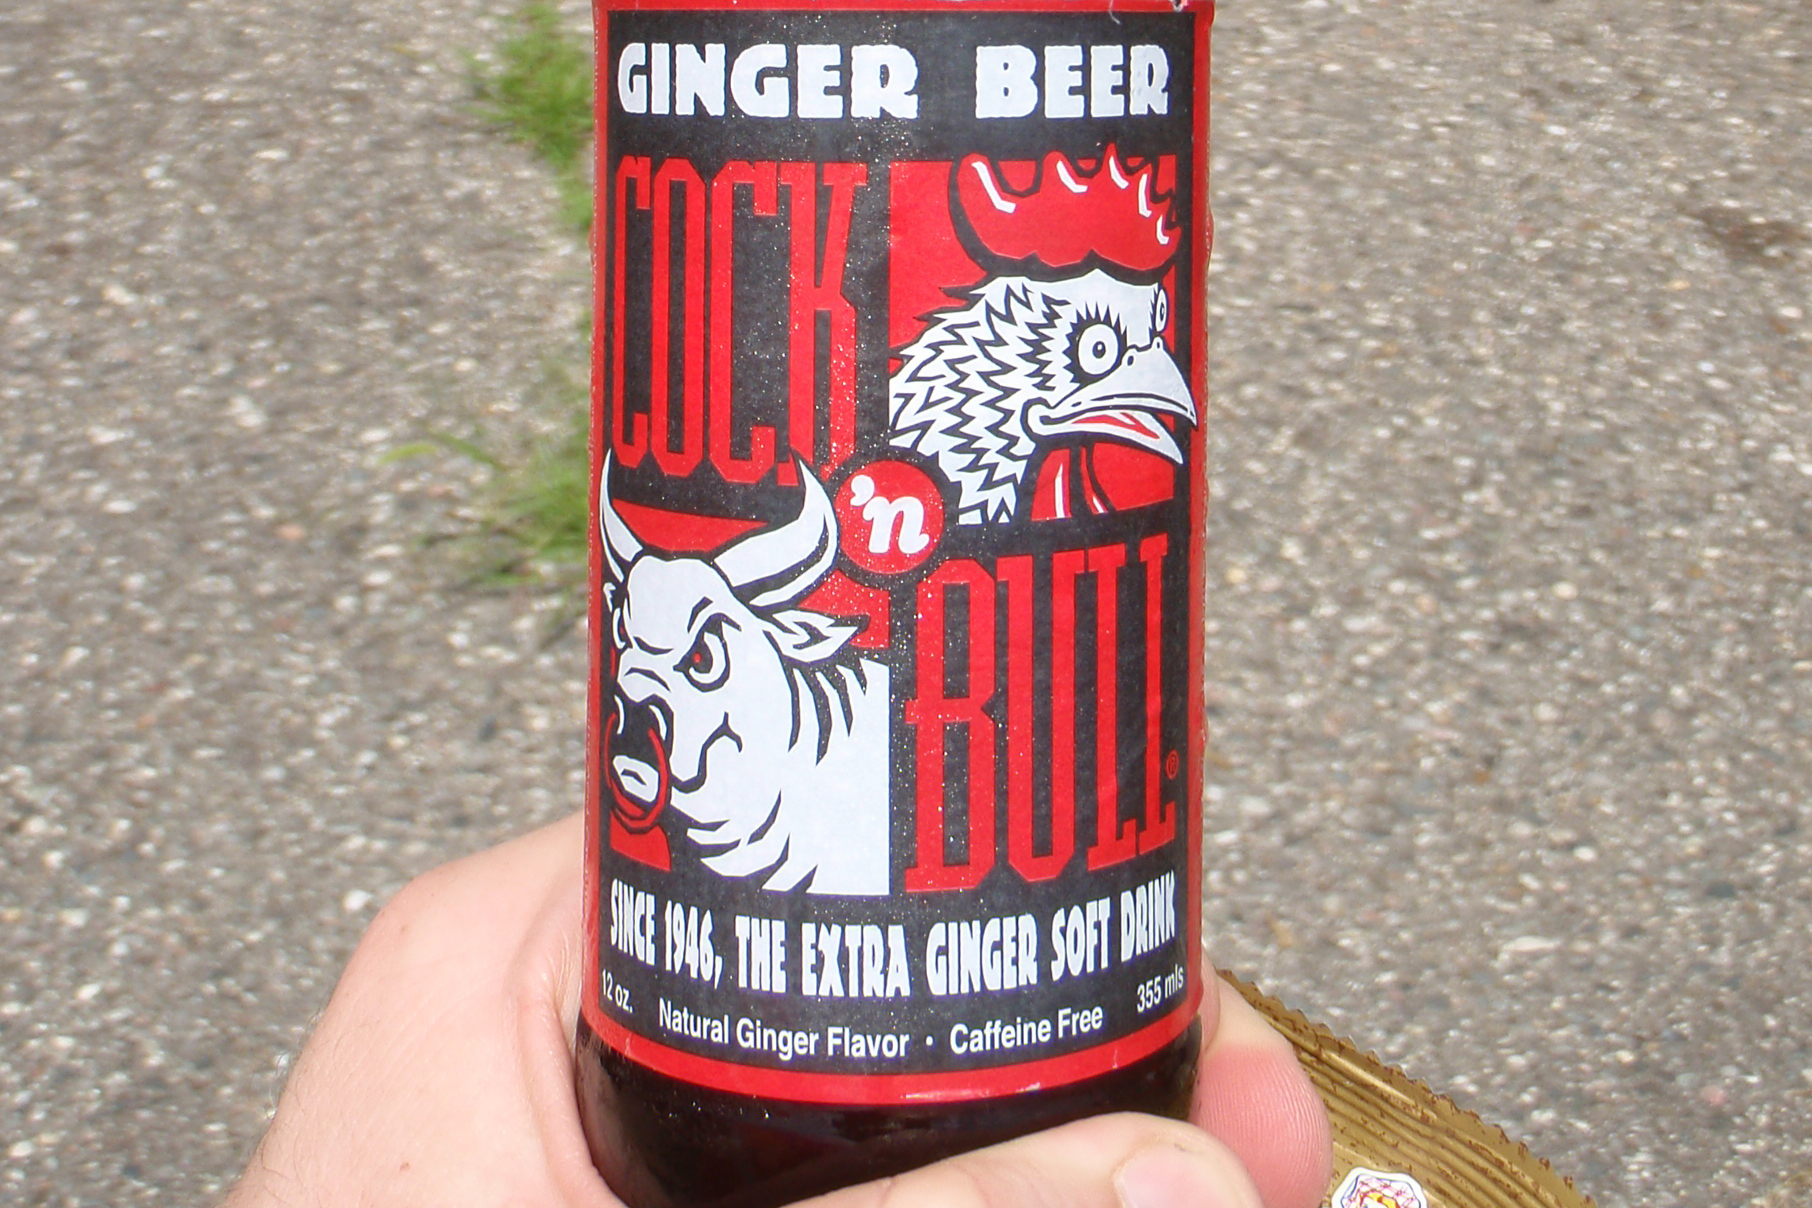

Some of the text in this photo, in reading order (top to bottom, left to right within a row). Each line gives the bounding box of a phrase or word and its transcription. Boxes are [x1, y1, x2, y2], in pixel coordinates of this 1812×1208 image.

[617, 42, 1171, 120] GINGER BEER
[612, 154, 868, 487] COCK
[849, 474, 930, 555] 'n
[904, 532, 1177, 894] BULL
[610, 869, 1176, 998] SINCE 1946, THE EXTRA GINGER SOFT DRINK
[602, 968, 633, 1013] 12 oz.
[1137, 963, 1184, 1013] 355 mls
[658, 996, 1104, 1061] Natural Ginger Flavor Caffeine Free
